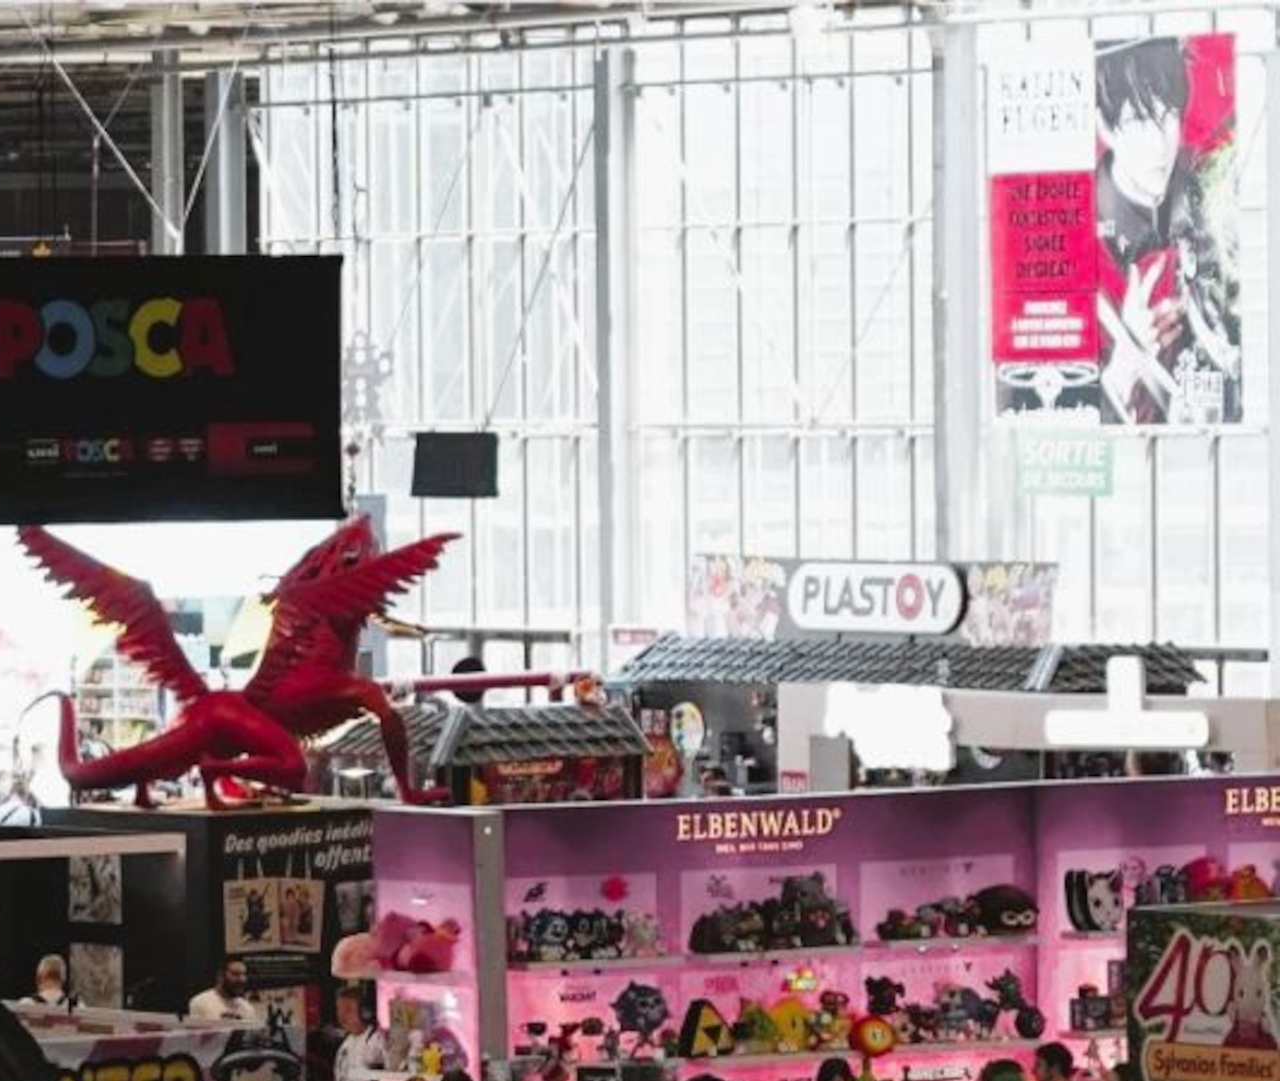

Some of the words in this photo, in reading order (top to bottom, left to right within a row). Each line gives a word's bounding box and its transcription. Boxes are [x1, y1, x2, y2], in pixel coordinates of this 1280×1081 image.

[803, 572, 946, 621] PLASTOY
[256, 826, 324, 853] goodies
[1137, 932, 1235, 1043] 40
[1219, 1047, 1275, 1080] Families
